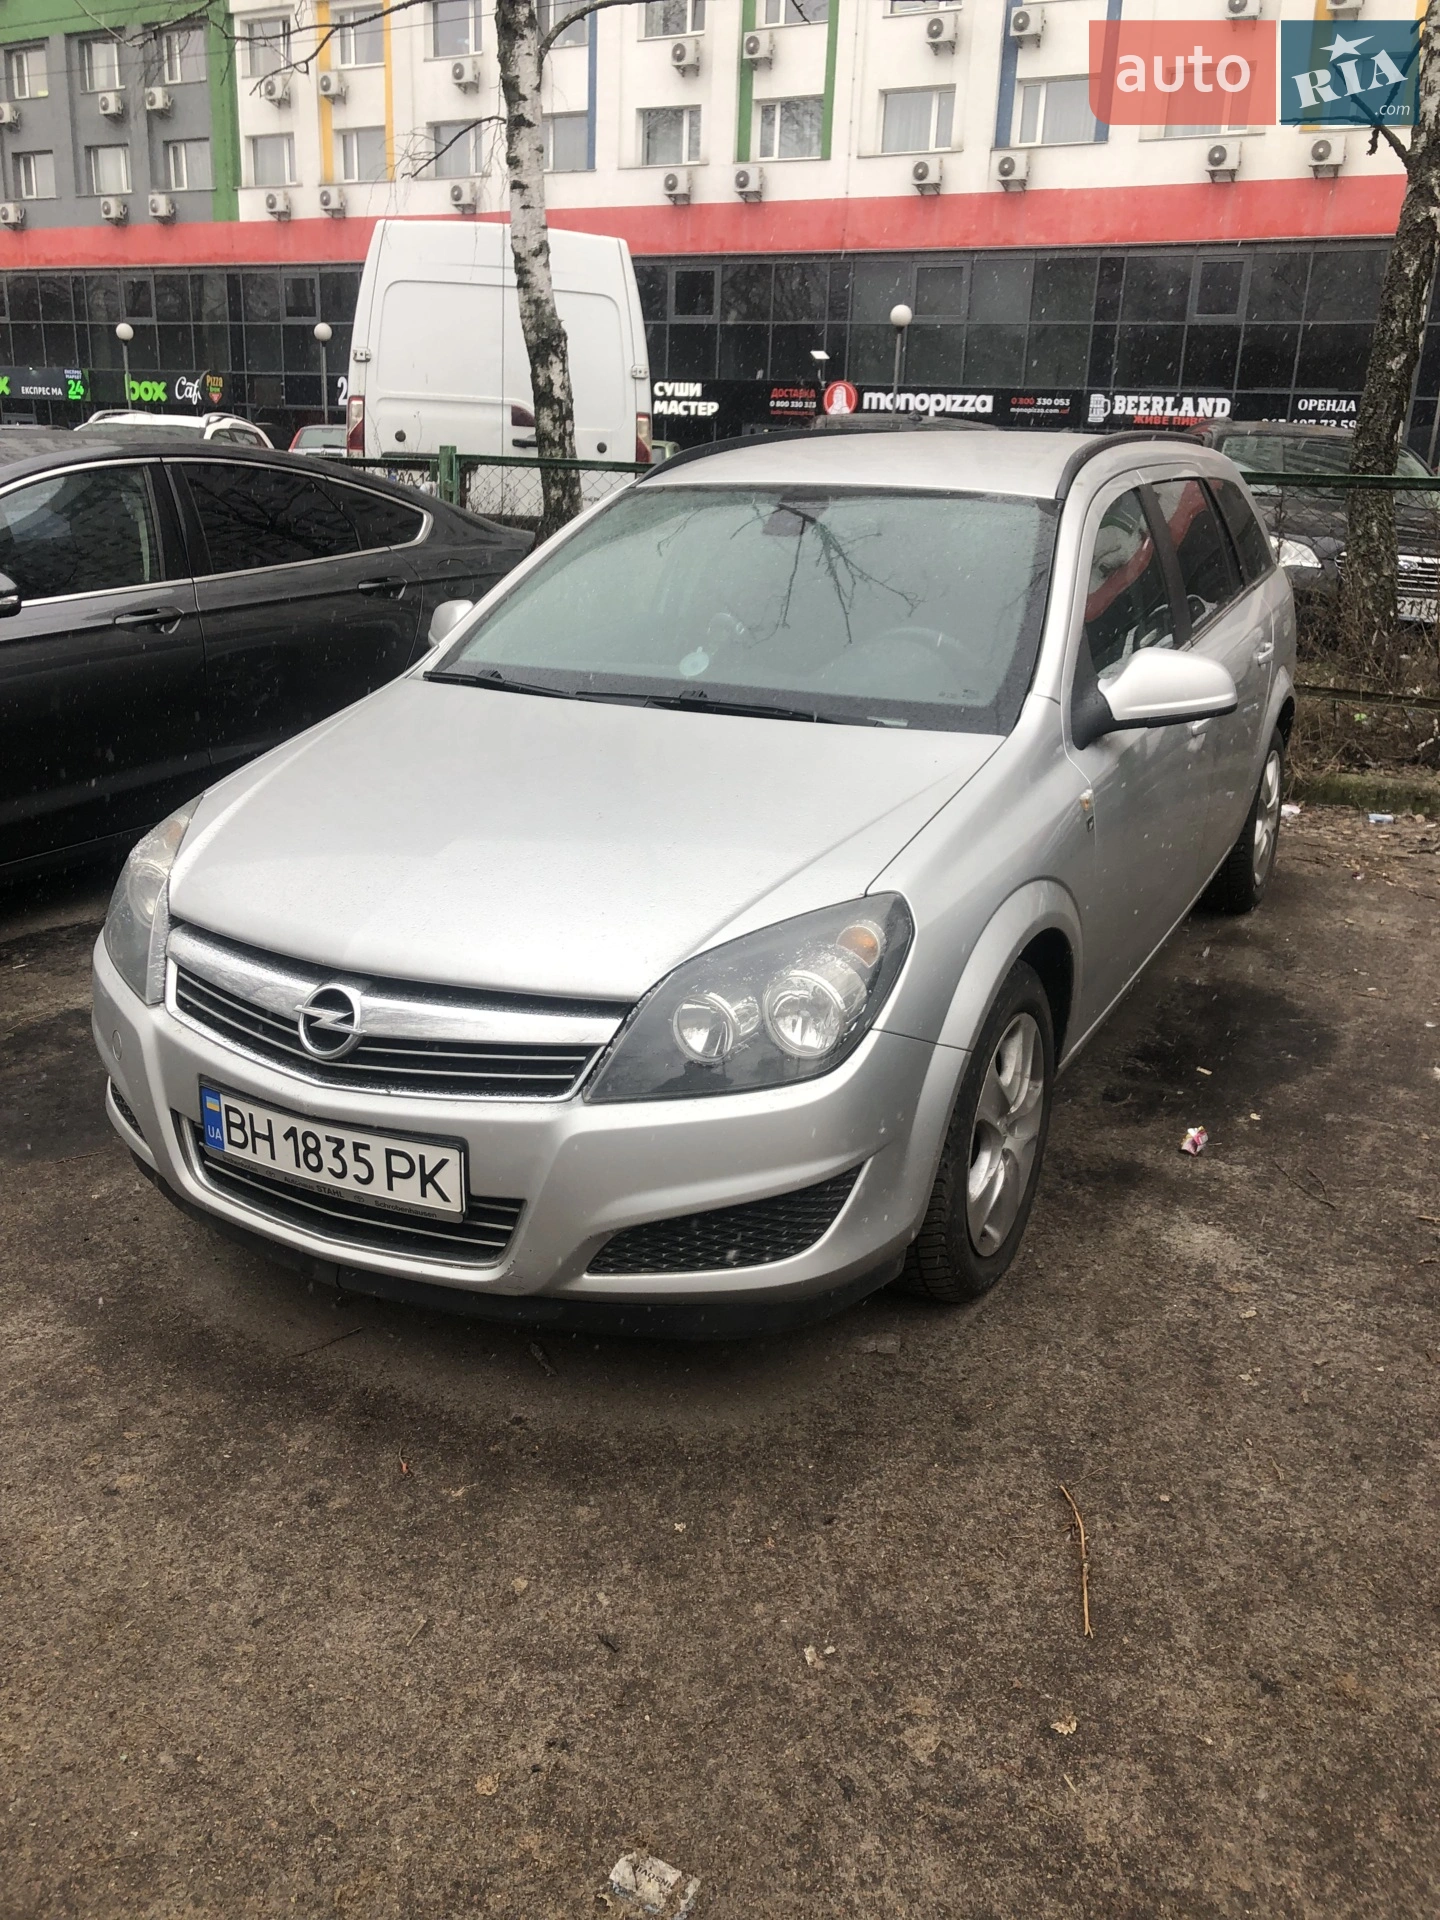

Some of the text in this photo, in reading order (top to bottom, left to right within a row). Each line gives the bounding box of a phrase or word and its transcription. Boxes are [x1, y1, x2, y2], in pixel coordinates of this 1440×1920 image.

[21, 386, 51, 395] ЕКСПРЕС
[67, 379, 85, 395] 24
[654, 381, 702, 398] СУШИ
[770, 388, 816, 398] ДОСТАВКА
[653, 400, 719, 417] МАСТЕР
[862, 391, 994, 417] monopizza
[1036, 397, 1053, 406] 330
[1112, 395, 1231, 418] BEERLAND
[1297, 399, 1357, 413] ОРЕНДА
[1133, 415, 1170, 425] ЖИВЕ
[207, 1124, 223, 1141] UA
[224, 1103, 452, 1203] BH 1835 PK
[316, 1184, 344, 1198] STAHL
[374, 1199, 437, 1219] Schrobenhausen
